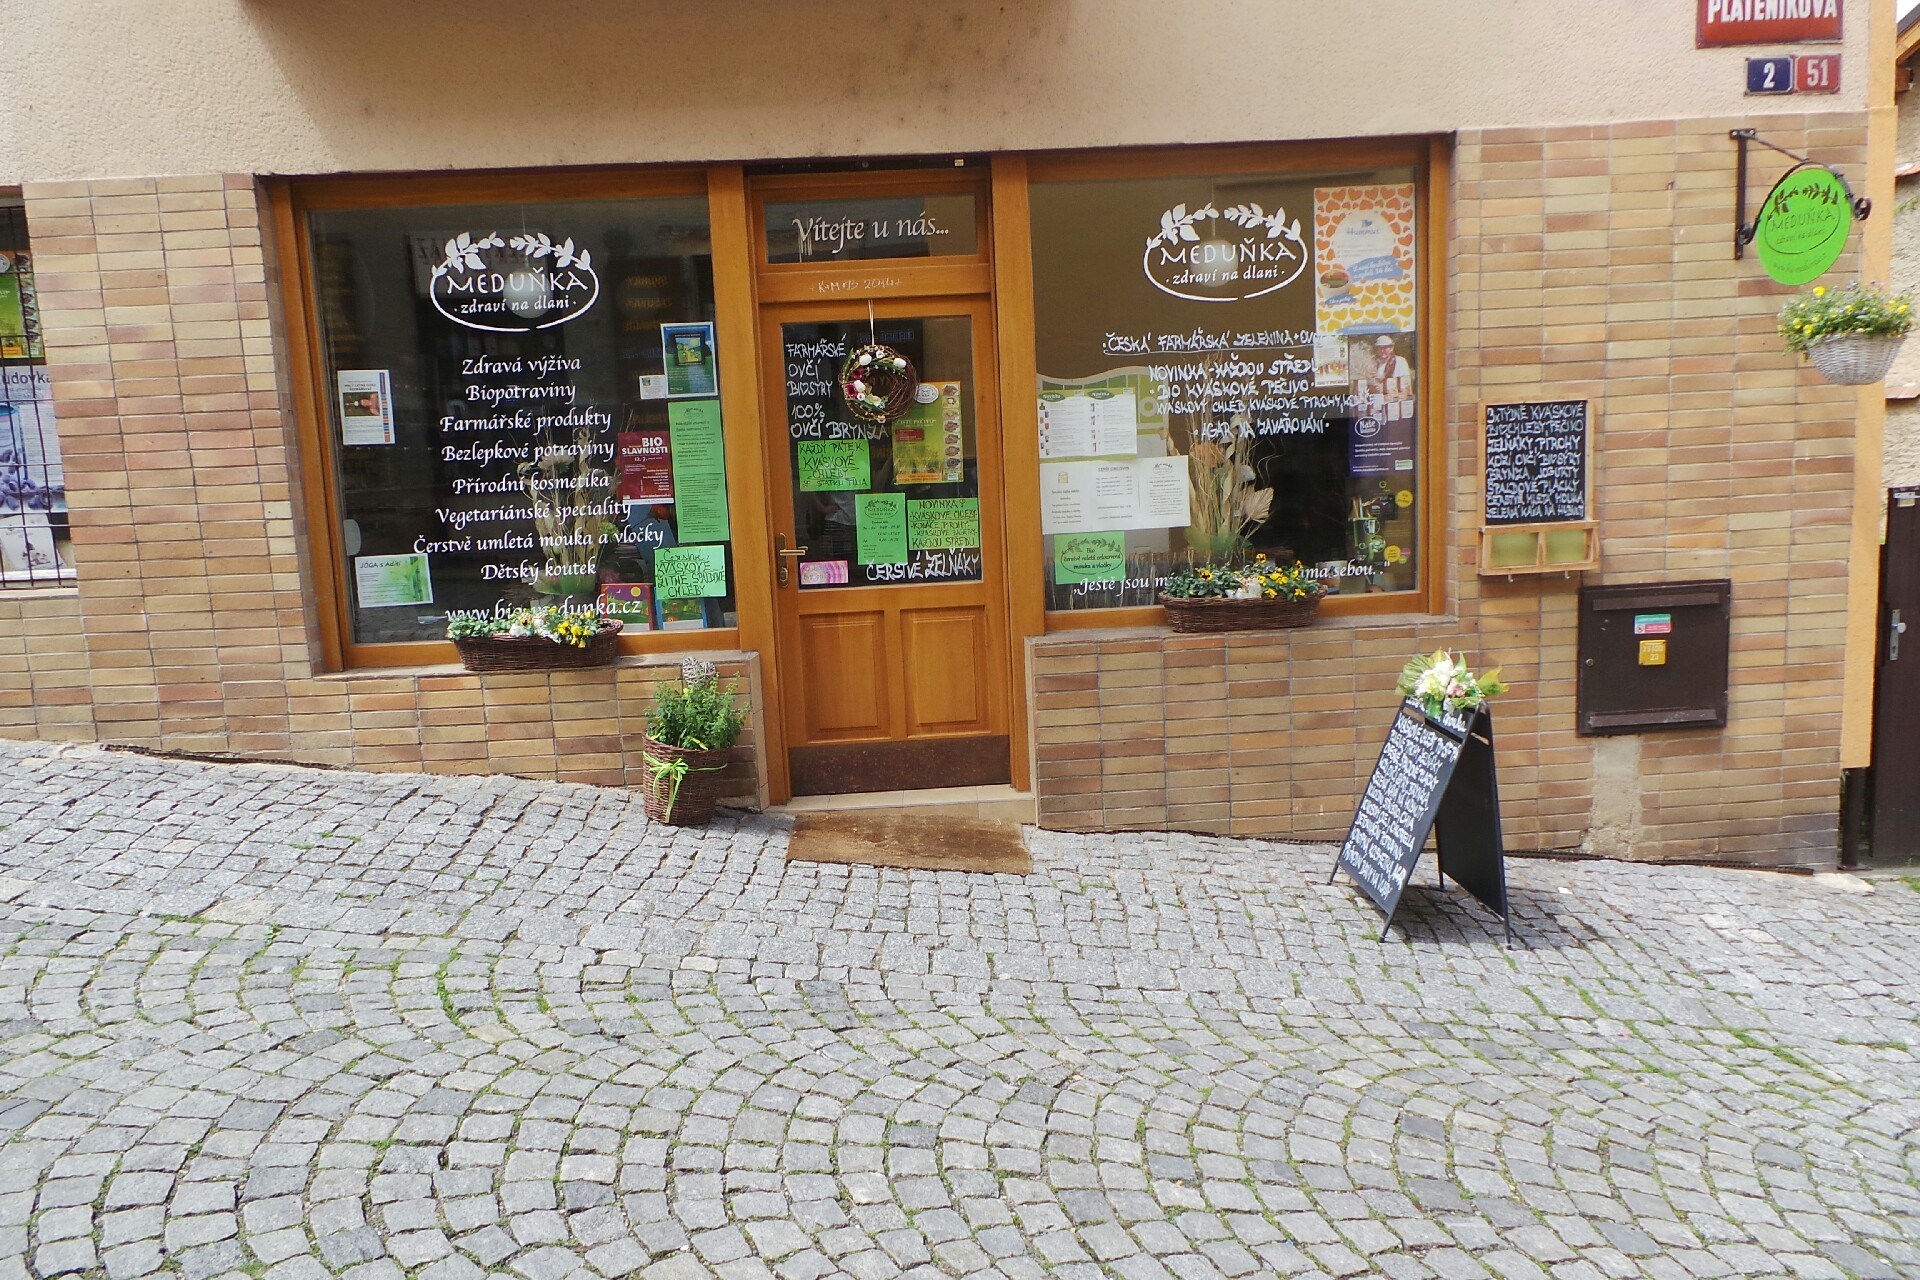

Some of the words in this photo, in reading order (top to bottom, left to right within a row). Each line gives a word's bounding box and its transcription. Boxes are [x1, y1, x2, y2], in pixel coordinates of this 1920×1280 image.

[1763, 62, 1775, 89] 2
[1807, 59, 1829, 87] 51
[792, 214, 865, 254] Vítejte
[872, 220, 889, 239] u
[896, 211, 949, 236] nás...
[1160, 238, 1297, 265] MEDUŇKA
[447, 266, 588, 294] MEDUŇKA
[1172, 270, 1217, 285] zdraví
[1221, 271, 1238, 281] na
[1243, 265, 1278, 279] dlani
[461, 299, 506, 314] zdraví
[511, 301, 529, 312] na
[534, 295, 570, 309] dlani
[462, 355, 523, 375] Zdravá
[527, 355, 581, 379] výžíva
[465, 382, 576, 408] Biopotraviny
[440, 409, 532, 432] Farmářské
[533, 406, 611, 436] produkty
[792, 403, 825, 419] 100%
[641, 437, 663, 447] BIO
[790, 418, 824, 438] OVČÍ
[826, 421, 888, 440] BRYNZA
[1239, 420, 1255, 438] NA
[441, 440, 529, 468] Bezlepkové
[530, 442, 614, 466] potraviny
[622, 447, 668, 455] SLAVNOSTI
[452, 472, 525, 495] Přírodní
[530, 469, 610, 491] kosmetika
[435, 500, 550, 530] Vegetariánské
[555, 497, 631, 526] speciality
[413, 535, 472, 554] Čerstvě
[476, 530, 533, 550] umletá
[539, 527, 593, 547] mouka
[598, 532, 609, 544] a
[613, 523, 664, 549] vločky
[481, 559, 539, 585] Dětský
[545, 556, 596, 577] koutek
[1117, 577, 1149, 597] jsou
